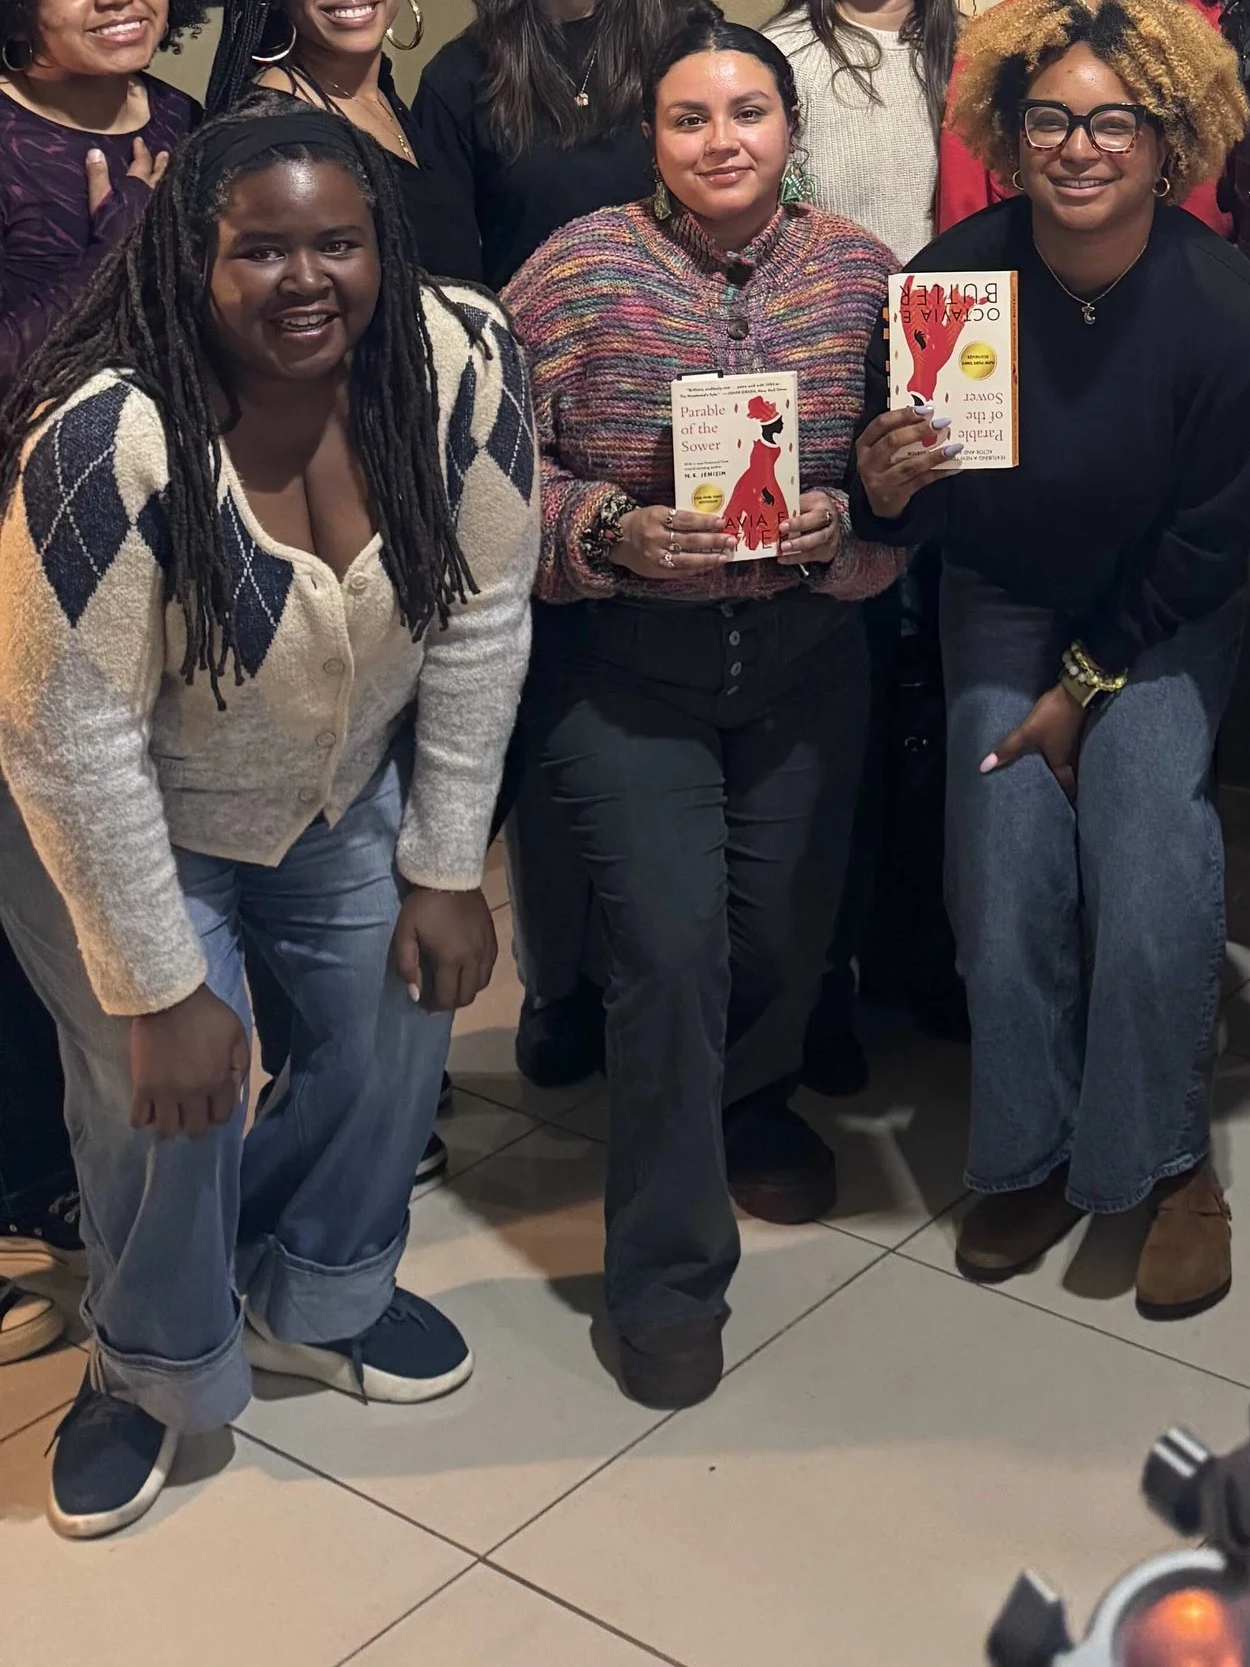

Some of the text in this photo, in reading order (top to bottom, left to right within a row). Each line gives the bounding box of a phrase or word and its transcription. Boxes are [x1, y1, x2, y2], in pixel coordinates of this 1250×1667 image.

[900, 282, 998, 305] BUTLER
[922, 308, 1000, 323] OCTAVIA
[964, 392, 1003, 405] Sower
[680, 403, 726, 418] Parable
[966, 411, 1003, 424] of the
[681, 421, 718, 435] of the
[958, 429, 1003, 442] Parable
[681, 441, 721, 453] Sower
